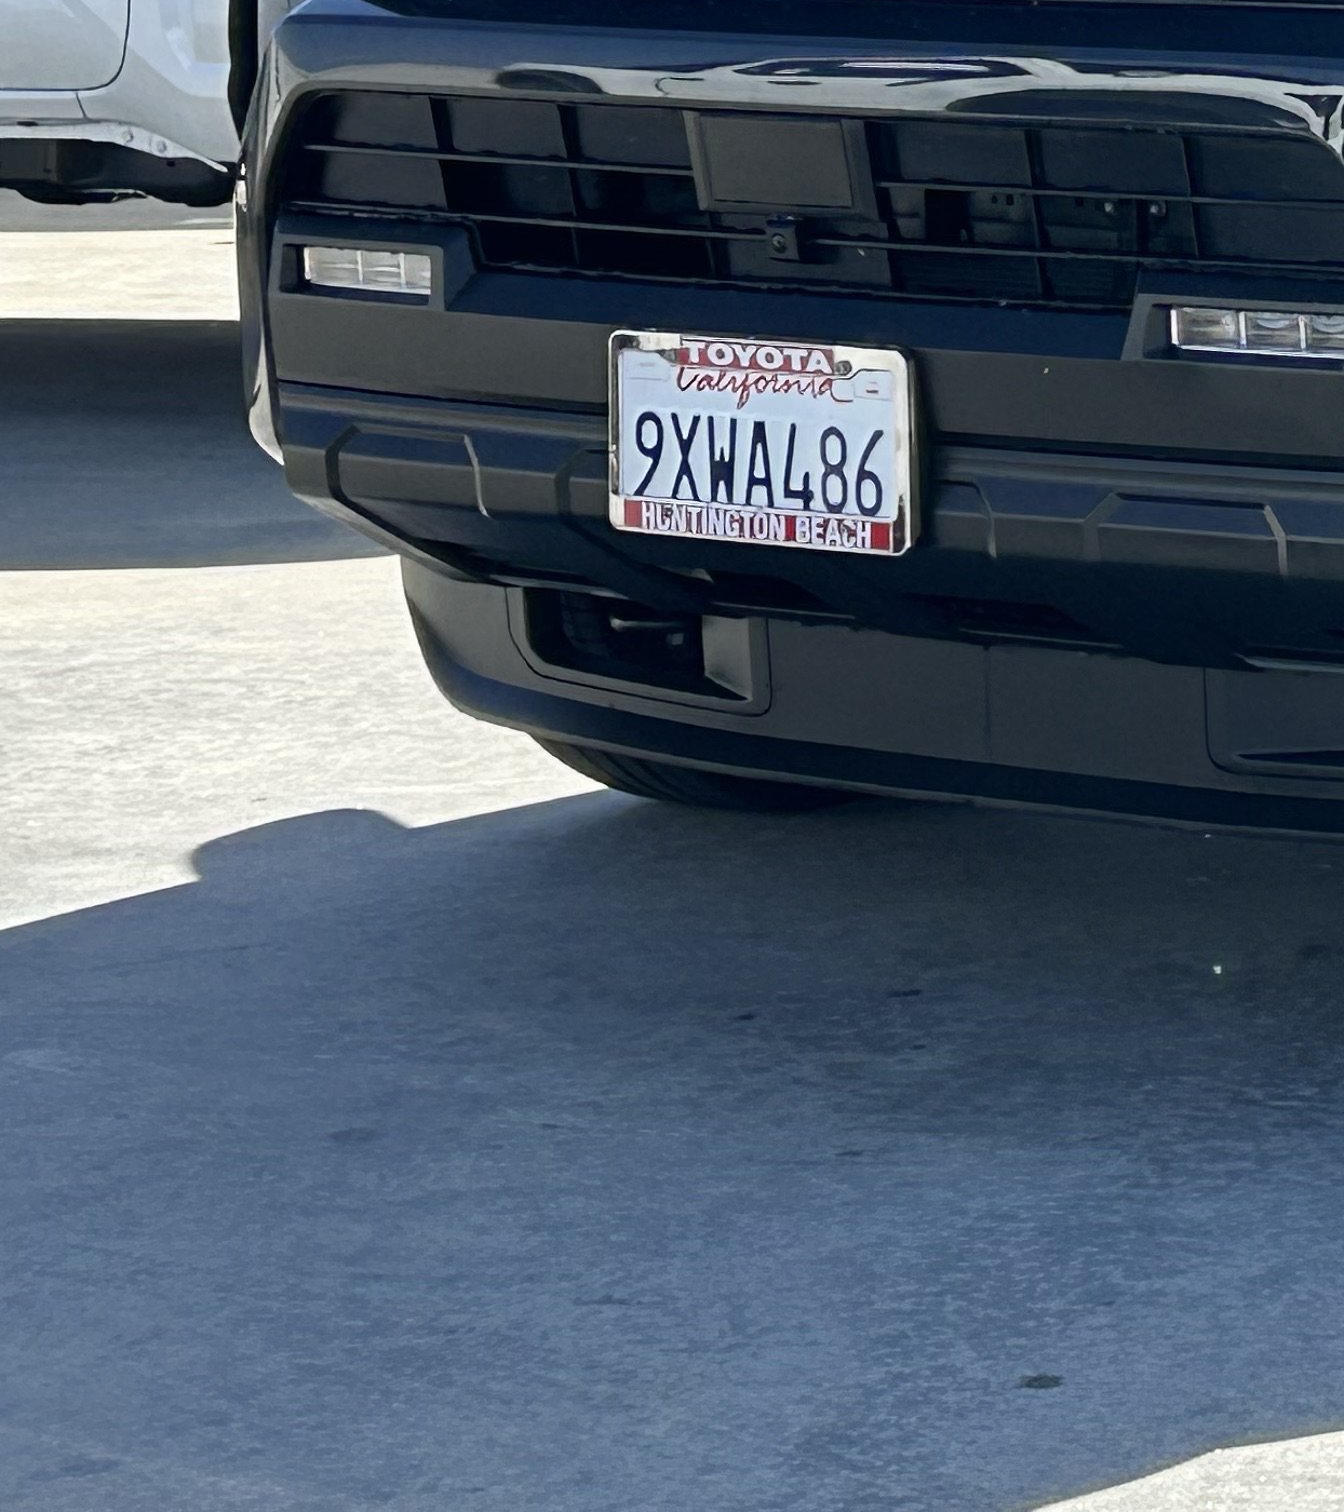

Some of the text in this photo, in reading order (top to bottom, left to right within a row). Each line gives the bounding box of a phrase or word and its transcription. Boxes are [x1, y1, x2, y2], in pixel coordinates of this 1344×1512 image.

[687, 341, 834, 374] TOYOTA
[674, 367, 856, 410] California
[635, 410, 885, 517] 9XWA486
[640, 500, 872, 550] HUNTINGTON BEACH
